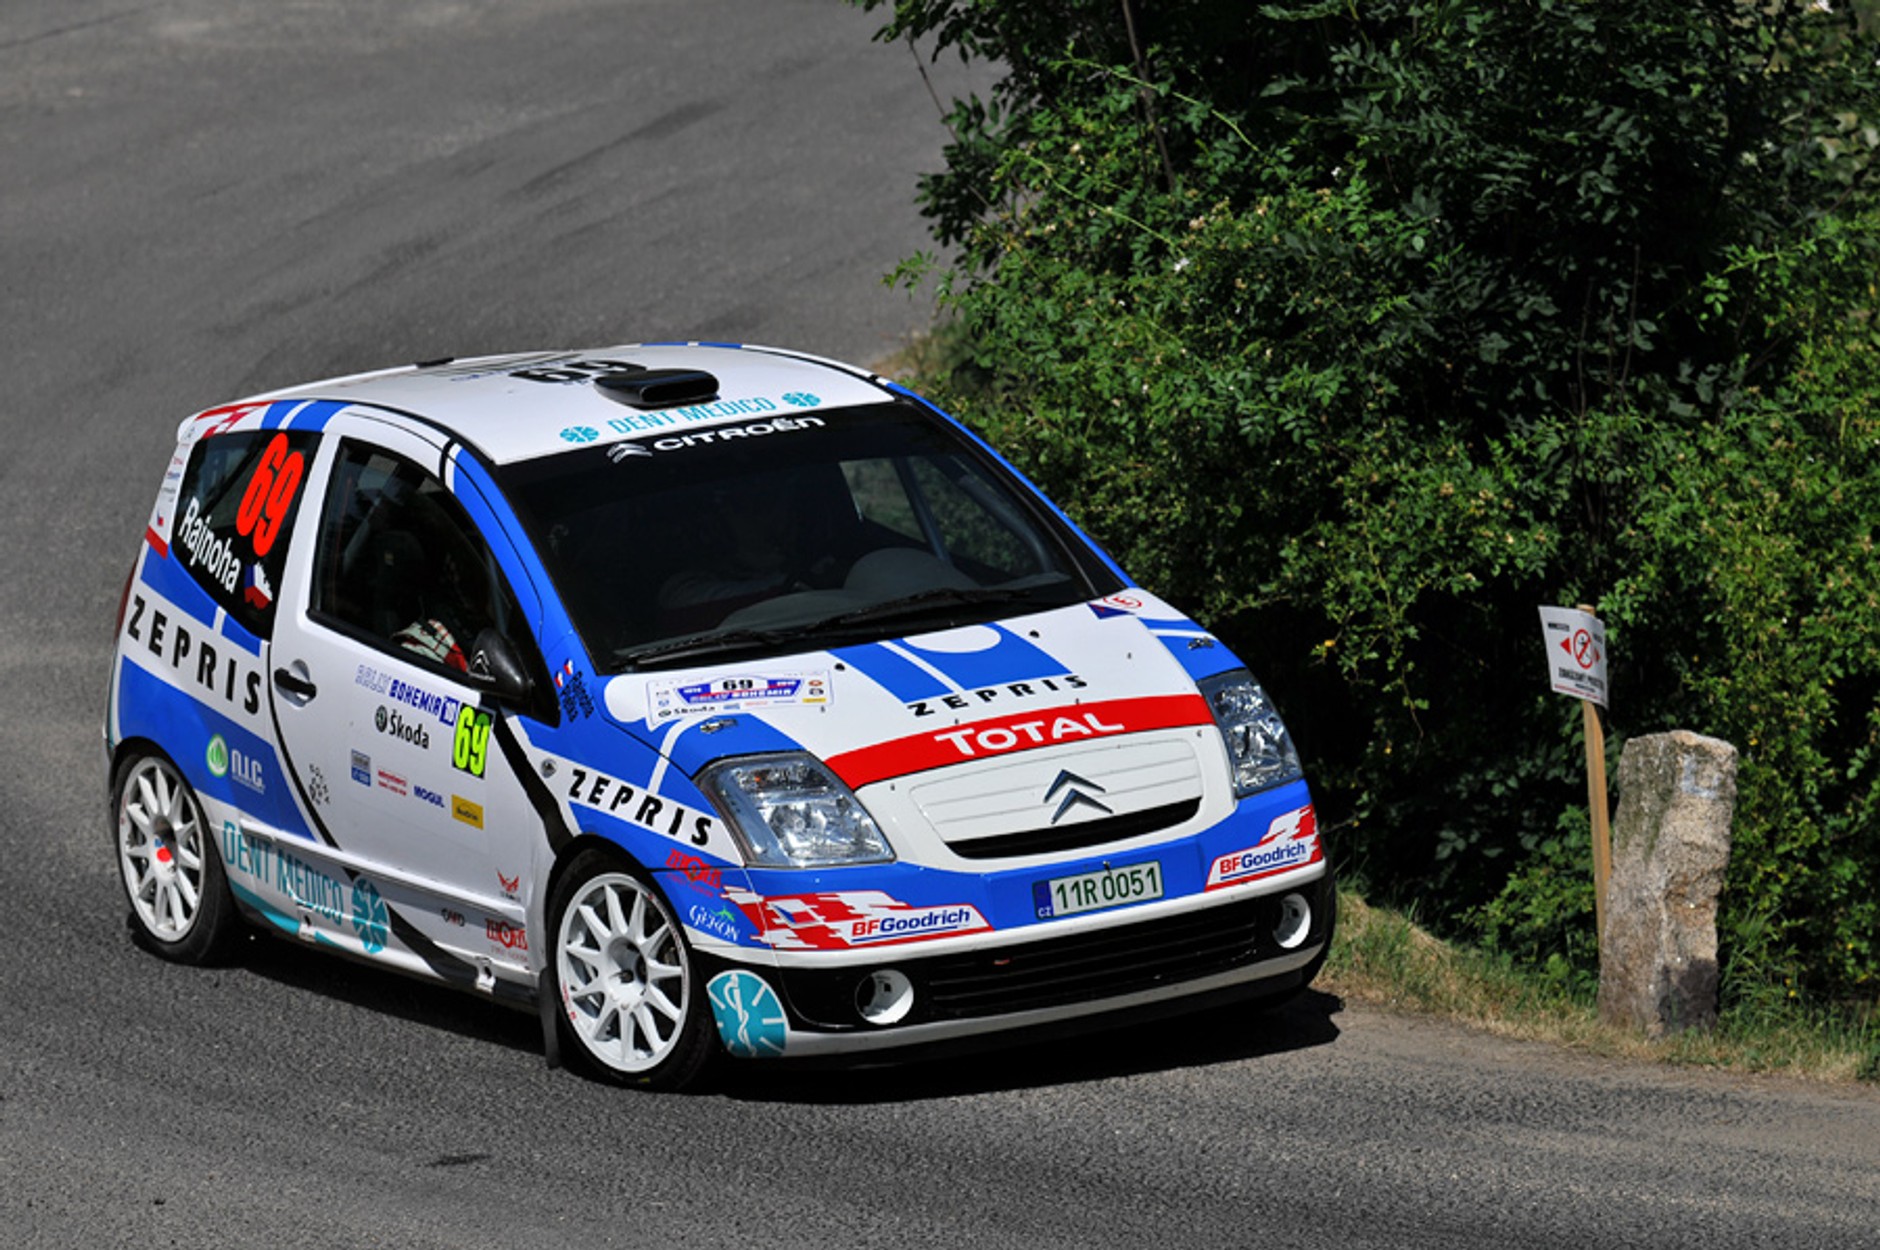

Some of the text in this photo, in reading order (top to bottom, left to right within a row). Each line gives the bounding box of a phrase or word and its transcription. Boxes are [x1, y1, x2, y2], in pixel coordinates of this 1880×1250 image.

[608, 397, 777, 434] DENT MEDICO
[236, 432, 304, 557] 69
[178, 496, 241, 594] Rajnoha
[127, 594, 262, 715] ZEPRIS
[389, 679, 442, 717] BOHEMIA
[723, 679, 753, 690] 69
[906, 675, 1088, 718] ZEPRIS
[389, 709, 430, 749] Škoda
[454, 706, 490, 776] 69
[934, 713, 1125, 756] TOTAL
[569, 769, 712, 846] ZEPRIS
[223, 819, 344, 926] DENT MEDICO
[1219, 841, 1306, 874] BFGoodrich
[1056, 867, 1159, 910] 11R 0051
[851, 908, 971, 937] BFGoodrich
